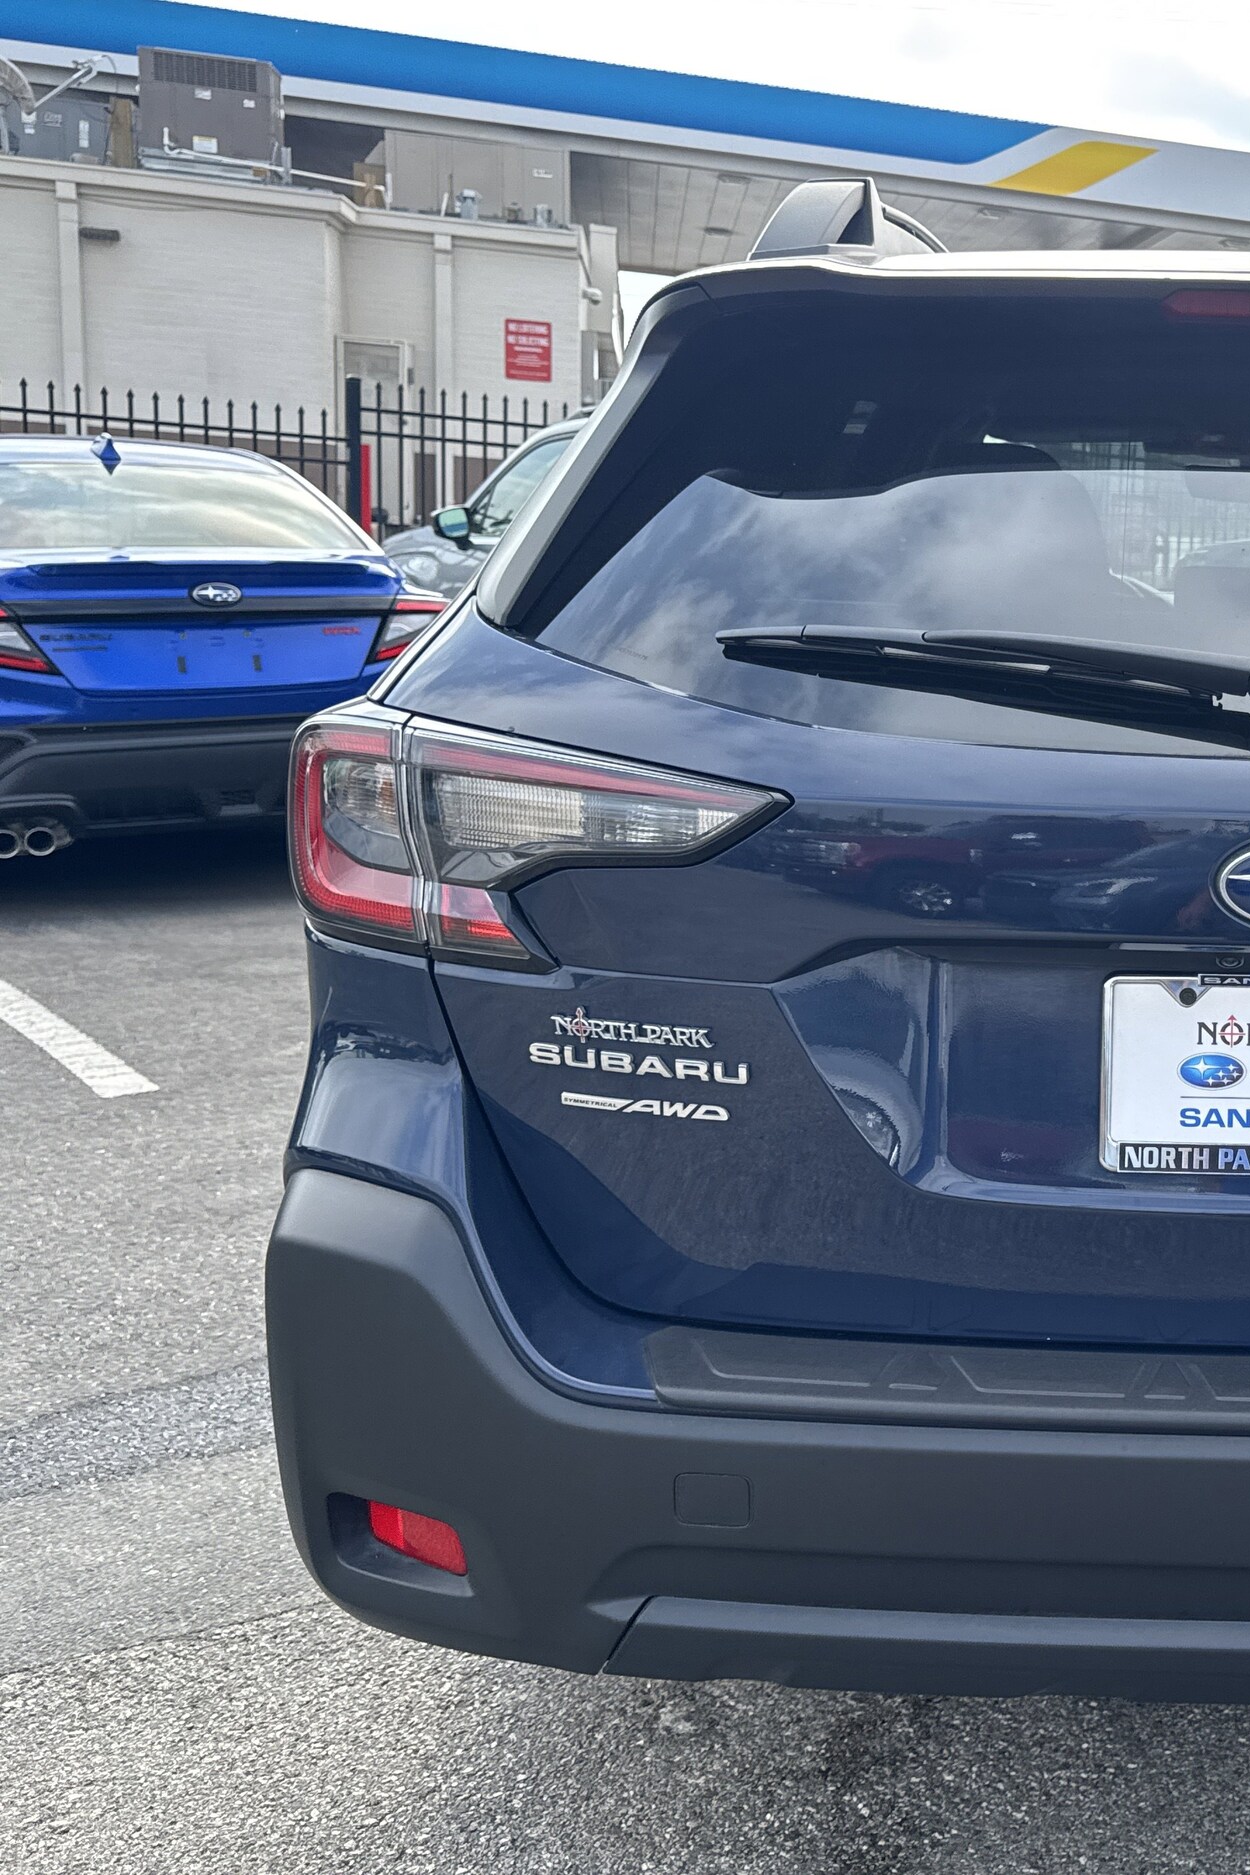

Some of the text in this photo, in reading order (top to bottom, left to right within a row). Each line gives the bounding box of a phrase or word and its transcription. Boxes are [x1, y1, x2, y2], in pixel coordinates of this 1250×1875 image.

[550, 1013, 716, 1049] NORTH PARK
[529, 1042, 750, 1085] SUBARU
[563, 1096, 731, 1121] SYMMETRICAL AWD
[1124, 1146, 1210, 1170] NORTH
